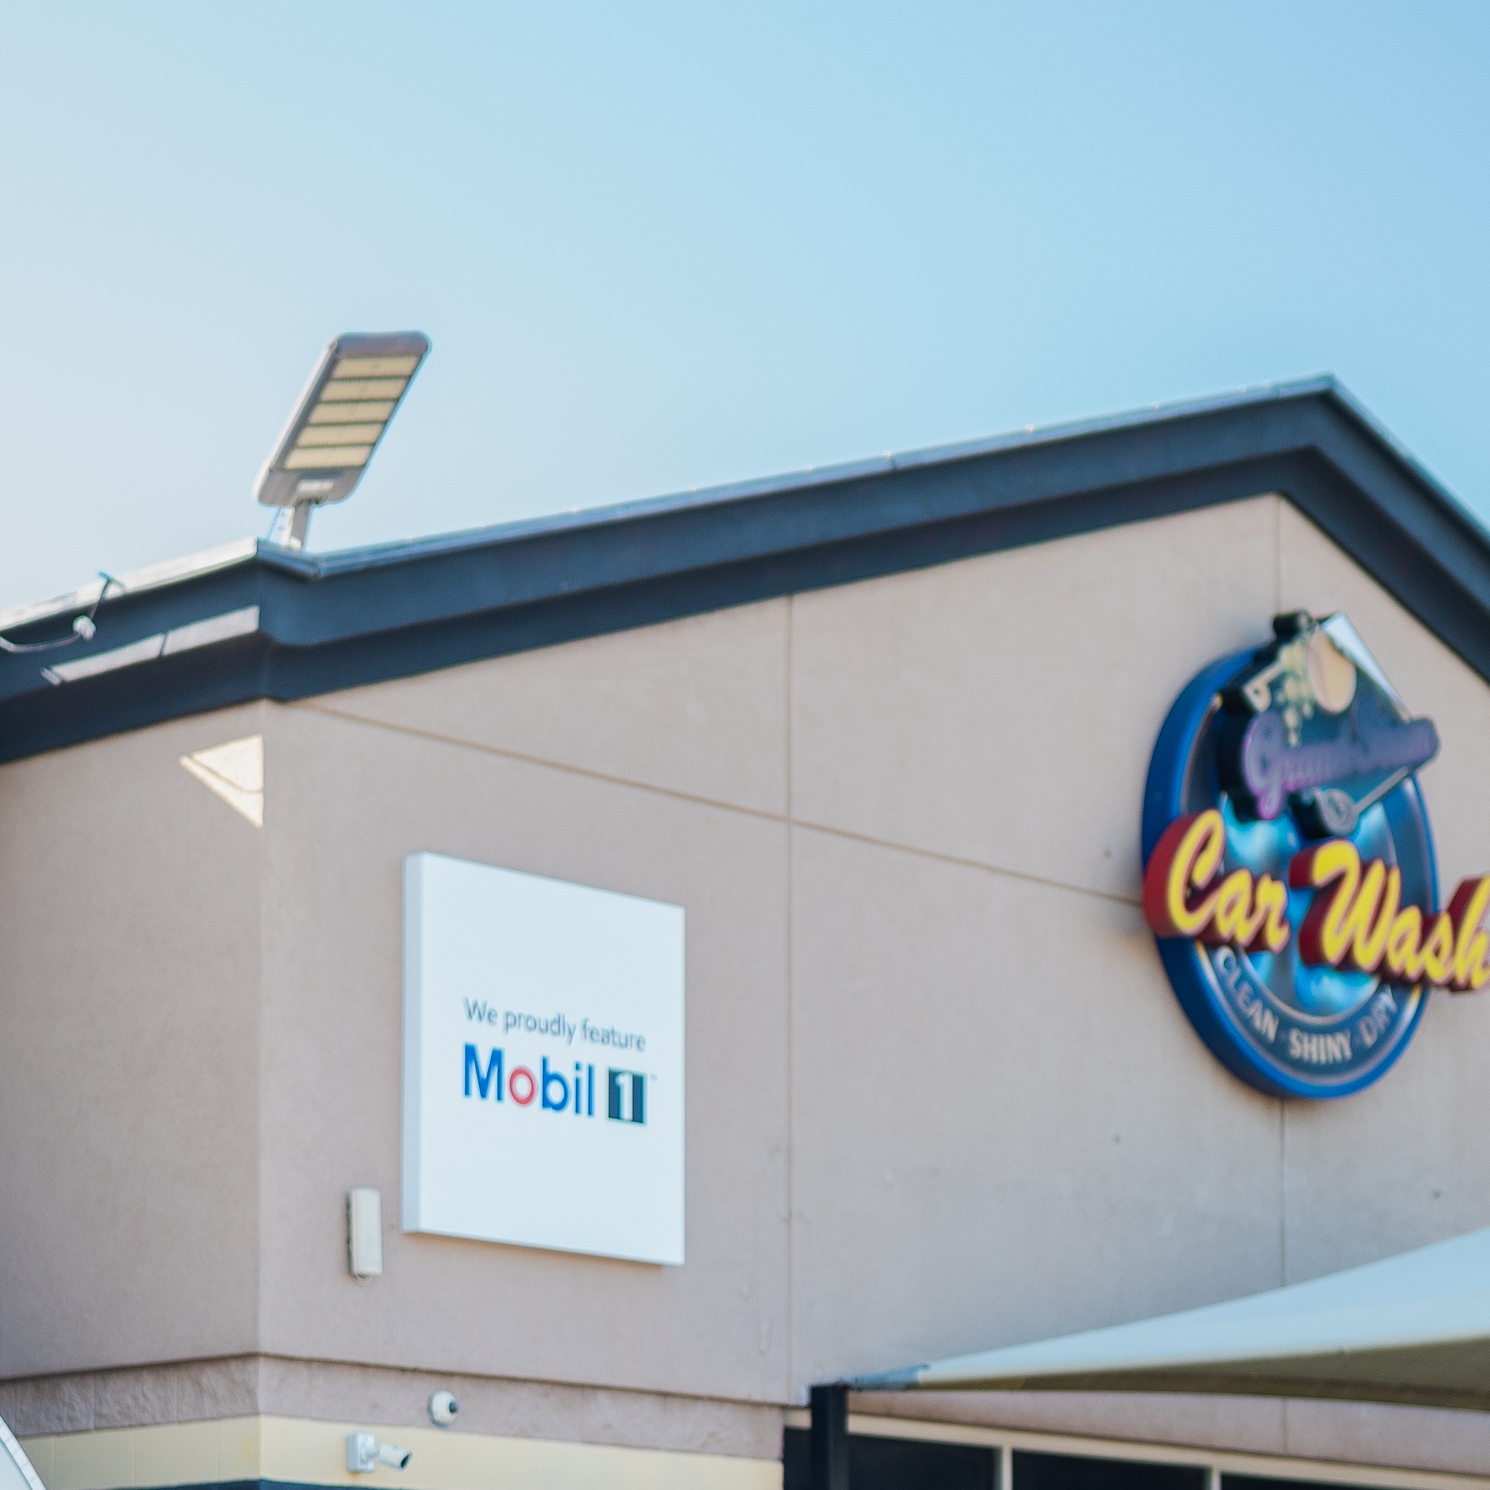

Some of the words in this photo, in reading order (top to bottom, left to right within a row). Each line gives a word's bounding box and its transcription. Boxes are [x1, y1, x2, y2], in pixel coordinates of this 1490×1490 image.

[1159, 808, 1291, 953] Car
[464, 997, 498, 1025] We
[503, 1011, 576, 1046] proudly
[581, 1017, 646, 1051] feature
[1214, 945, 1279, 1043] CLEAN
[1289, 1028, 1352, 1065] SHINY
[1358, 984, 1398, 1047] DRY
[464, 1042, 594, 1117] Mobil
[610, 1070, 643, 1124] 1
